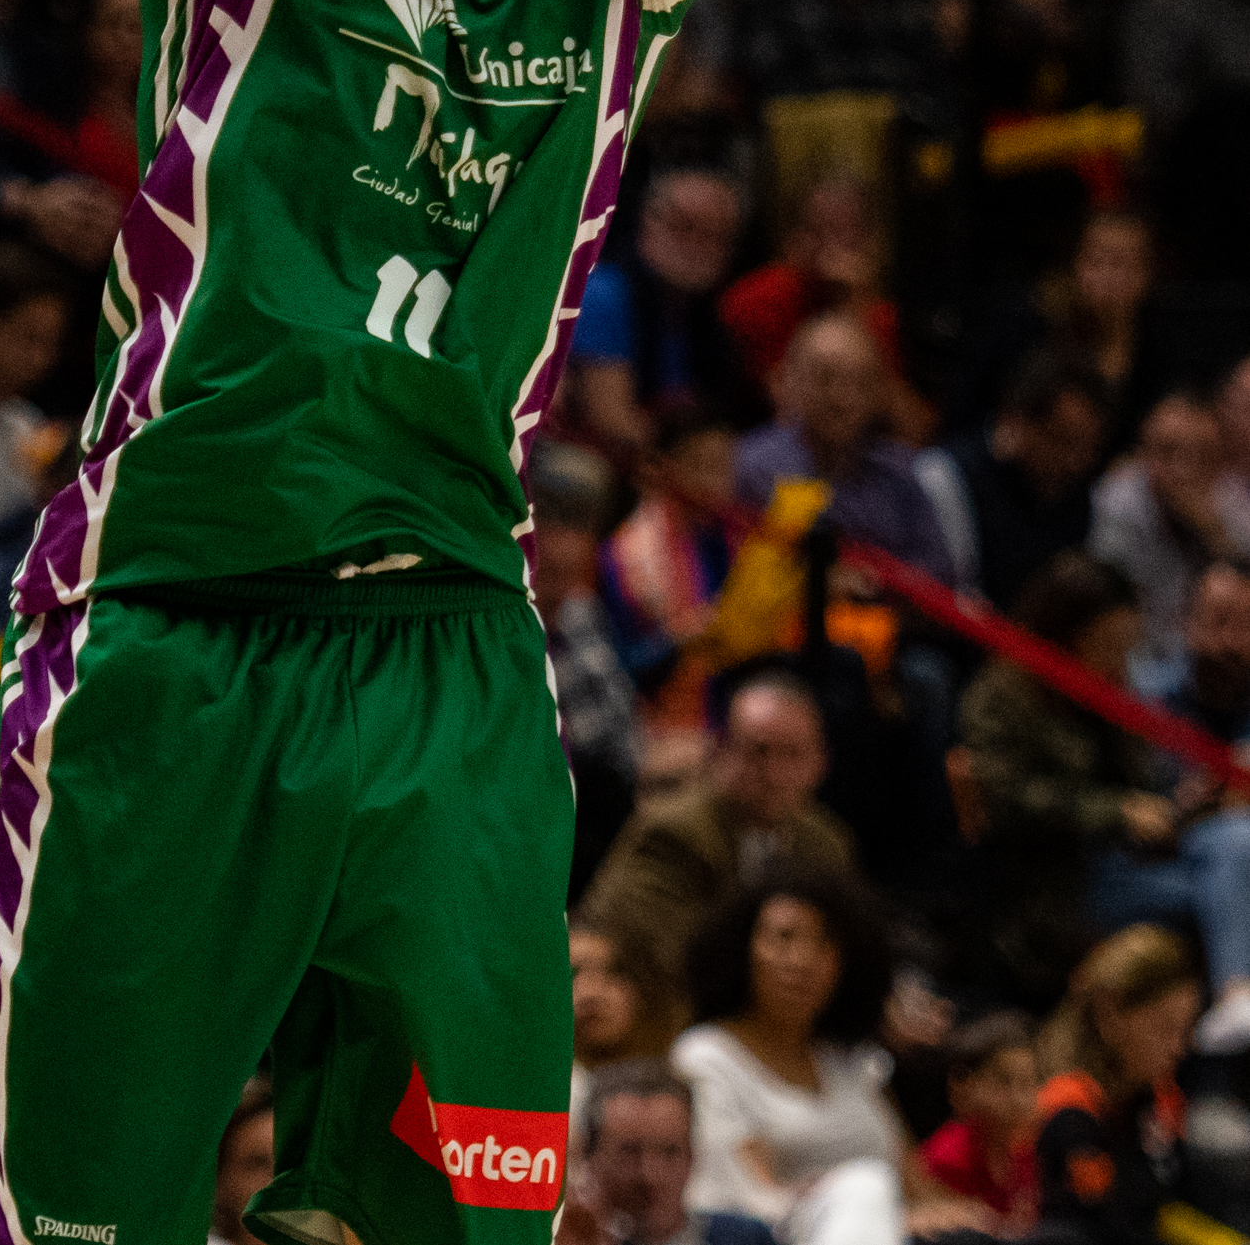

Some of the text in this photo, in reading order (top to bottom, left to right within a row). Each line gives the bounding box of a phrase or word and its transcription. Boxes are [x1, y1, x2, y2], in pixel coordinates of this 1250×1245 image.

[352, 165, 479, 232] Ciudad Genial
[365, 254, 453, 359] 11
[34, 1215, 117, 1245] SPALDING
